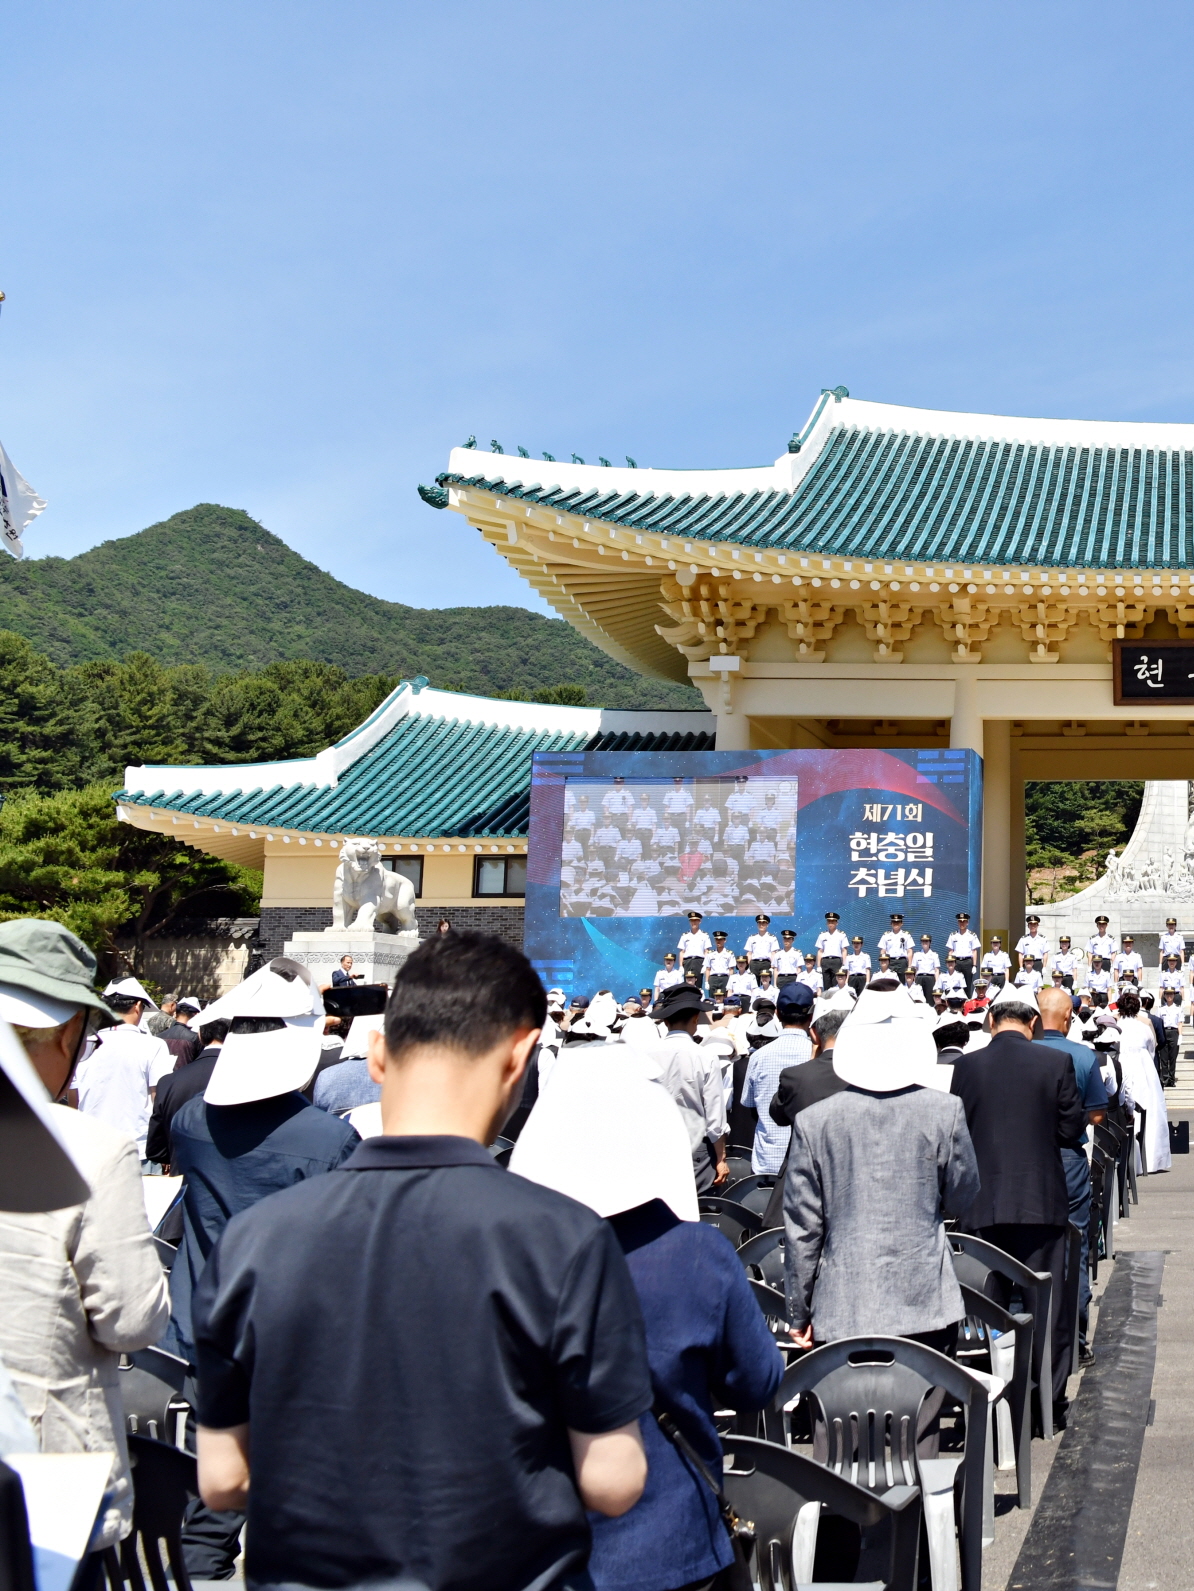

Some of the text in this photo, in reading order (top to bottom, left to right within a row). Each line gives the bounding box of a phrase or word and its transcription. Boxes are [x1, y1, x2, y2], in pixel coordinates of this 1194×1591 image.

[862, 803, 923, 823] 제71회
[848, 831, 935, 862] 현충일
[847, 867, 934, 898] 추념식
